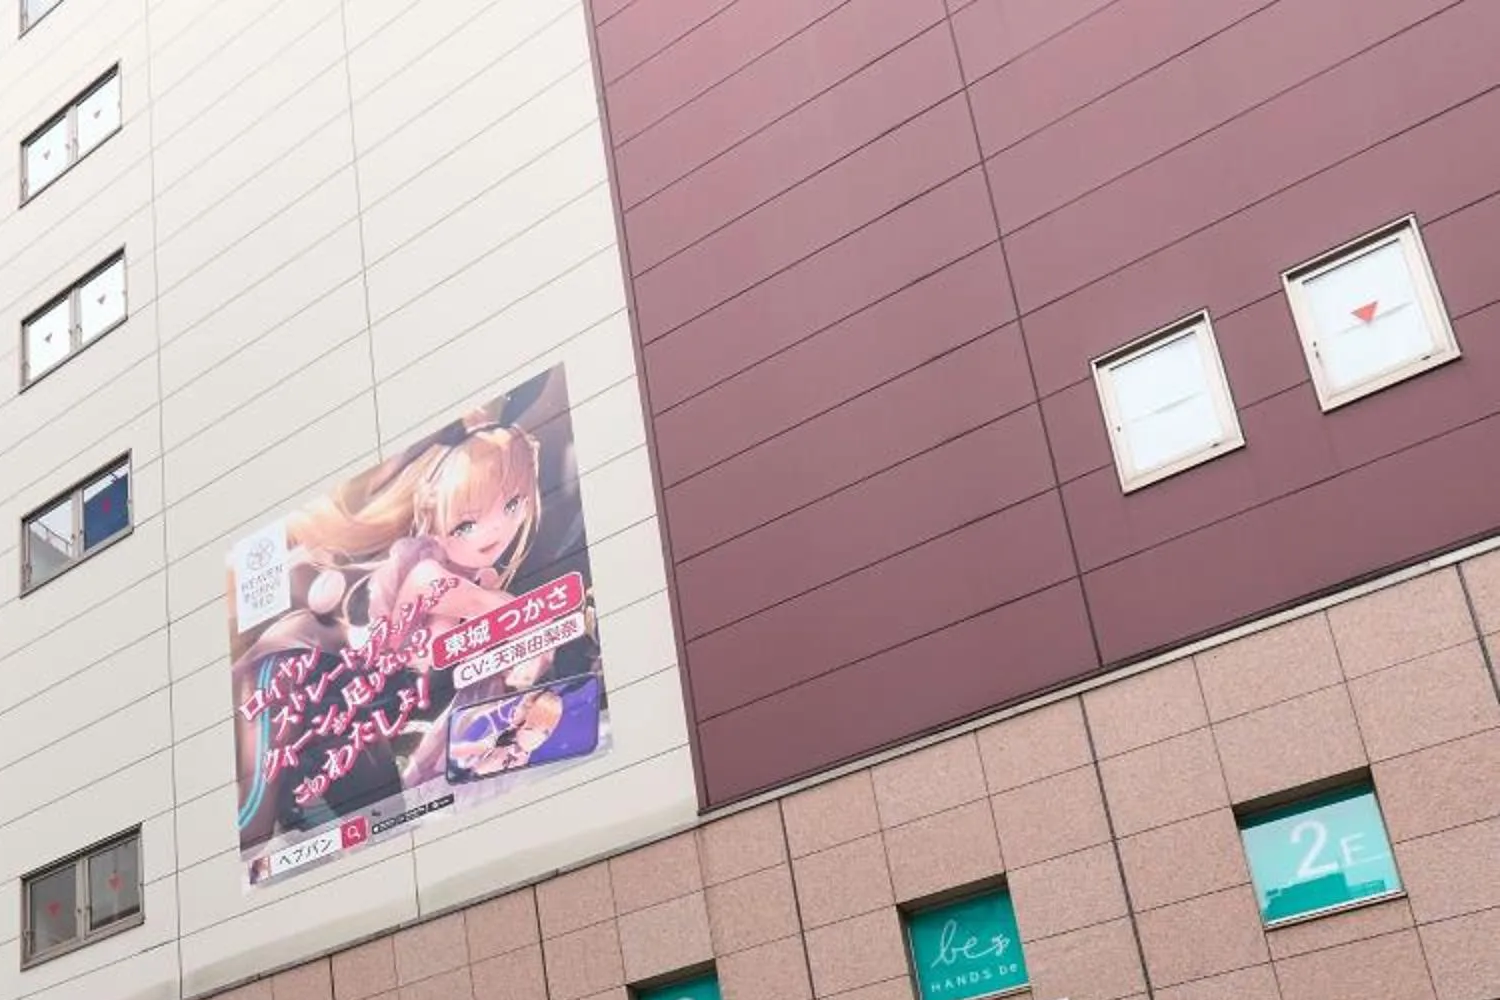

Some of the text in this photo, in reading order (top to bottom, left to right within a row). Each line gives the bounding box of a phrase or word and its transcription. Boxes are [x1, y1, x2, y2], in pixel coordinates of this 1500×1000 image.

[444, 583, 569, 660] 東城 つかさ
[1288, 818, 1369, 879] 2F
[930, 968, 992, 994] HANDS
